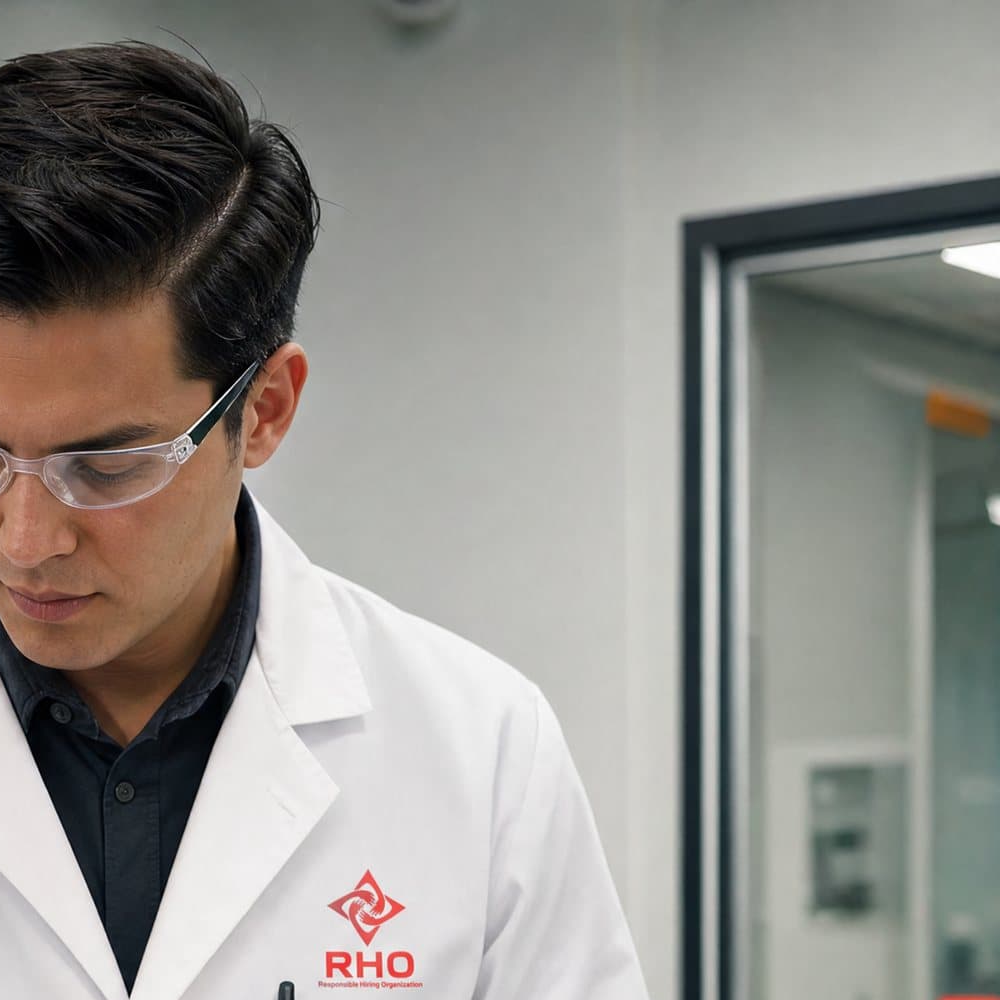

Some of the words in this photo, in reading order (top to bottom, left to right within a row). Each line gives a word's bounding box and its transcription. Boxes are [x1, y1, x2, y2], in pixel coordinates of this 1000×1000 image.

[325, 951, 415, 979] RHO
[318, 980, 358, 989] Responsible
[359, 980, 380, 989] Hiring
[381, 980, 423, 989] Organization
